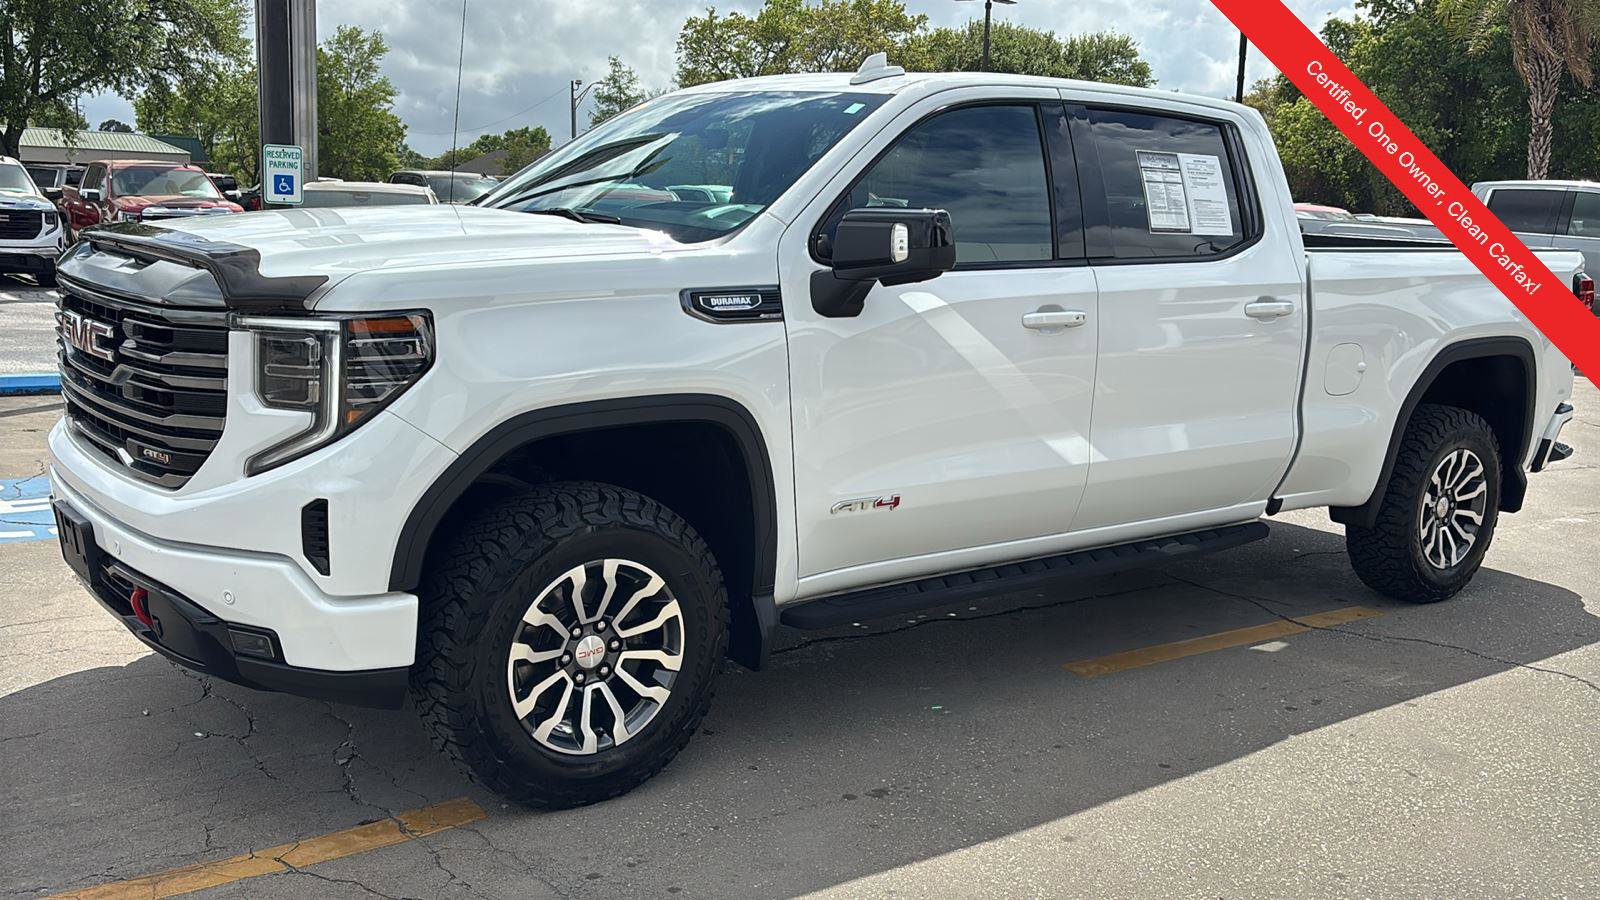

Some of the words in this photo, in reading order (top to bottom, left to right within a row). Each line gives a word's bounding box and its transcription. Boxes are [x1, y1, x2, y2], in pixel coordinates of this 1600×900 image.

[266, 150, 300, 160] RESERVED
[269, 160, 298, 169] PARKING
[710, 296, 752, 306] DURAMAX
[830, 494, 901, 514] AT4
[578, 646, 604, 659] GMC
